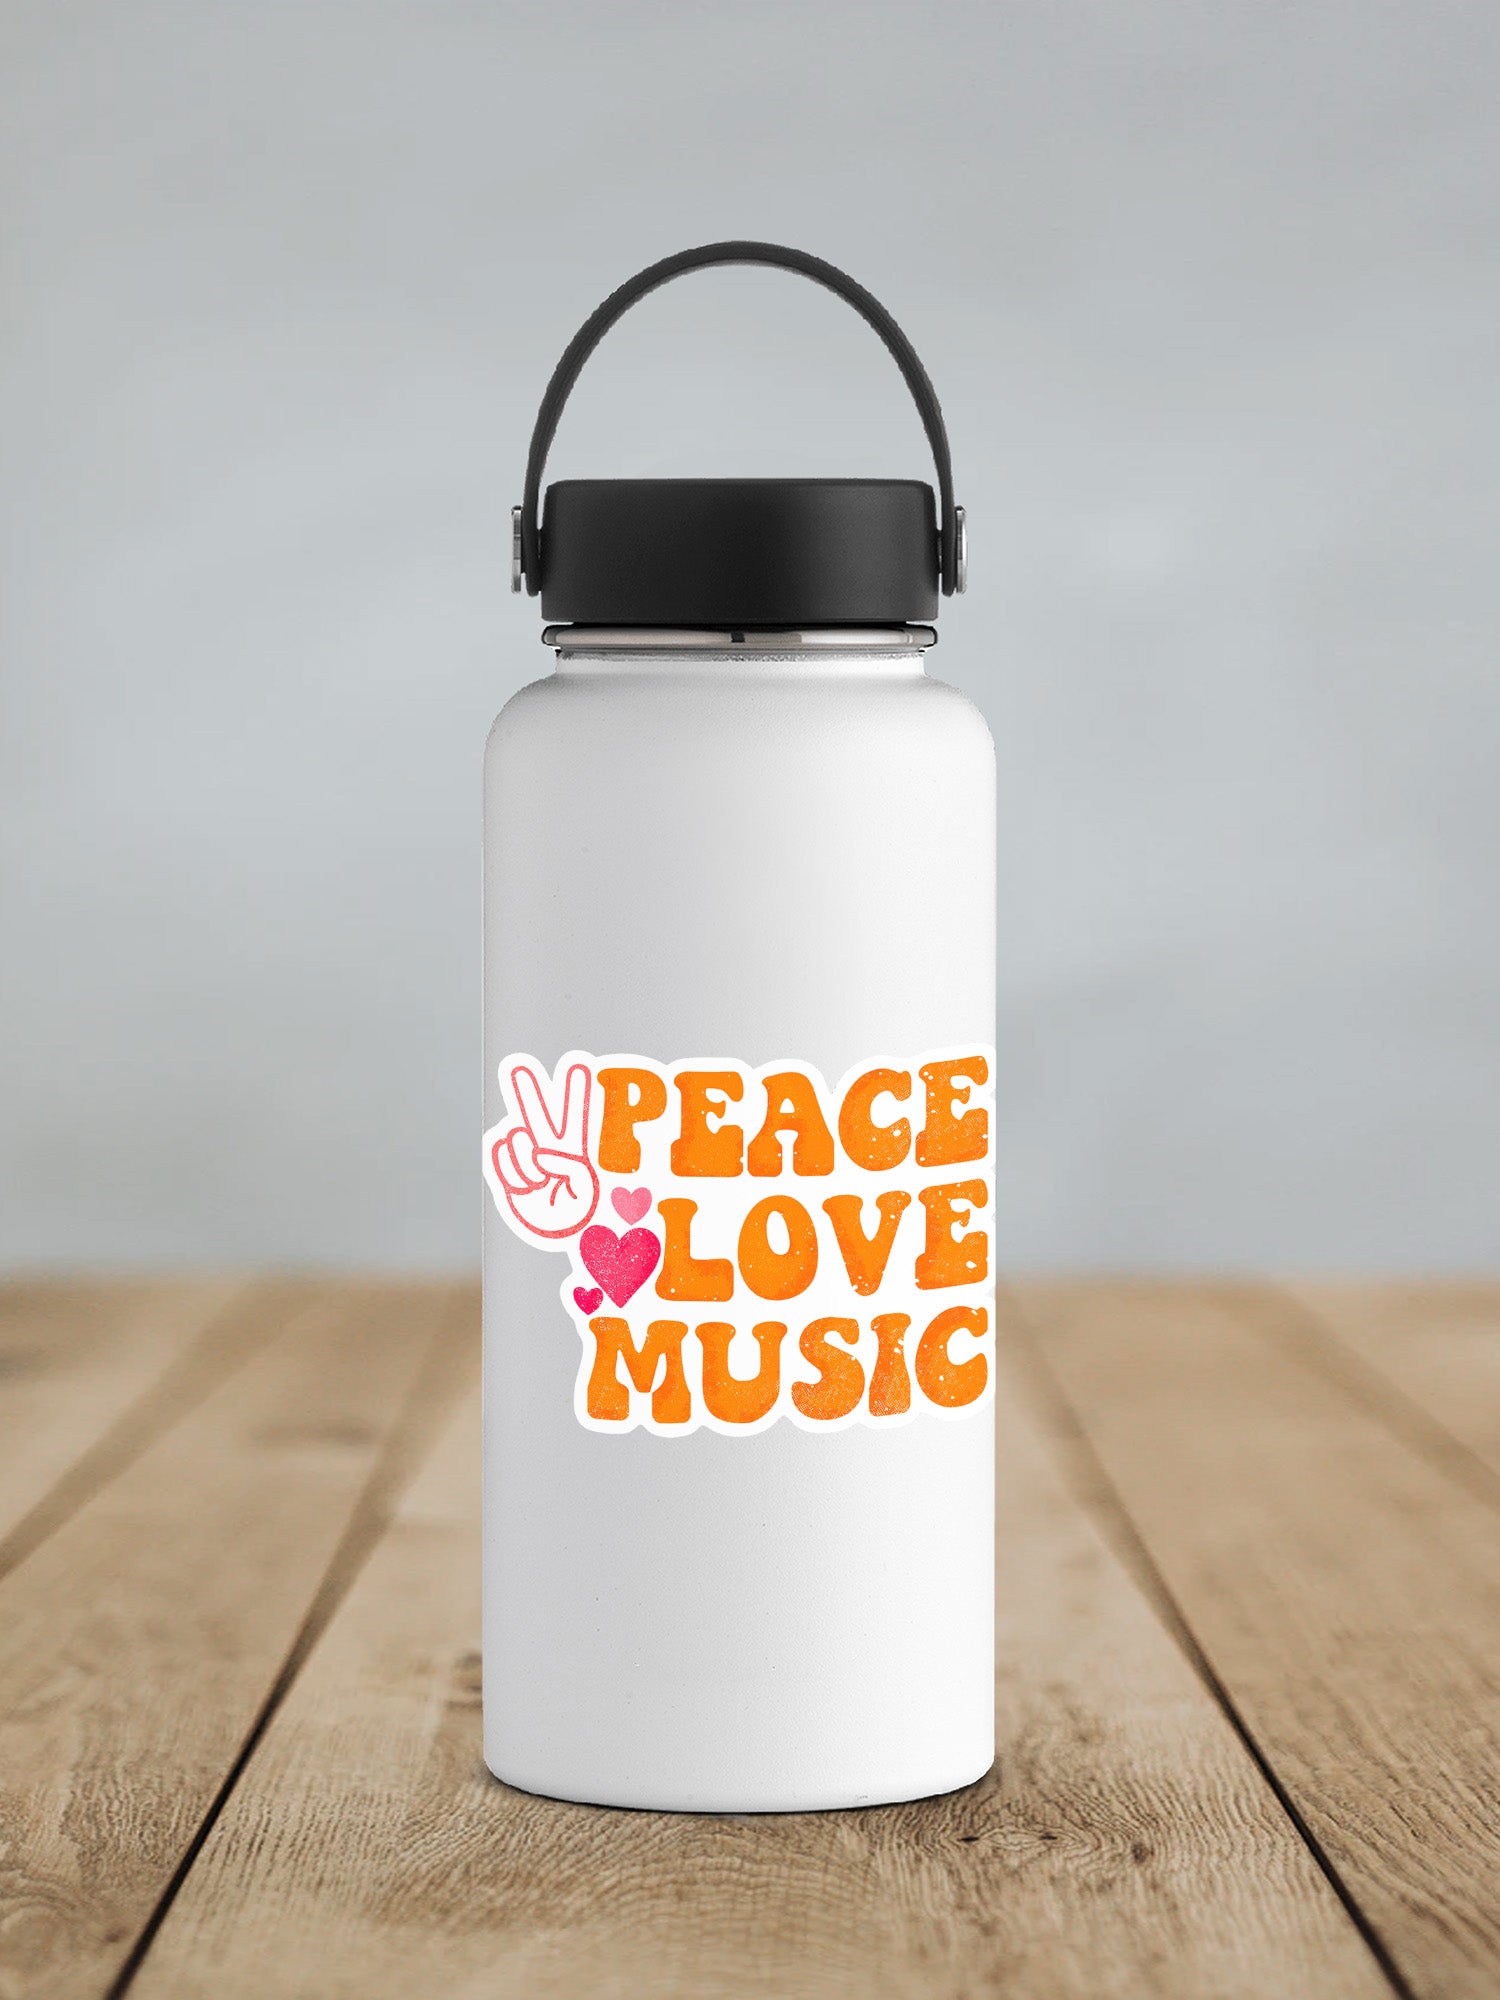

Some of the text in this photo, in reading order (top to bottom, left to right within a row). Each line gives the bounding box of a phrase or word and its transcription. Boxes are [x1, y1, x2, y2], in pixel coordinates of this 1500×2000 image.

[597, 1056, 988, 1177] PEACE
[655, 1179, 988, 1302] LOVE
[588, 1306, 988, 1424] MUSIC
